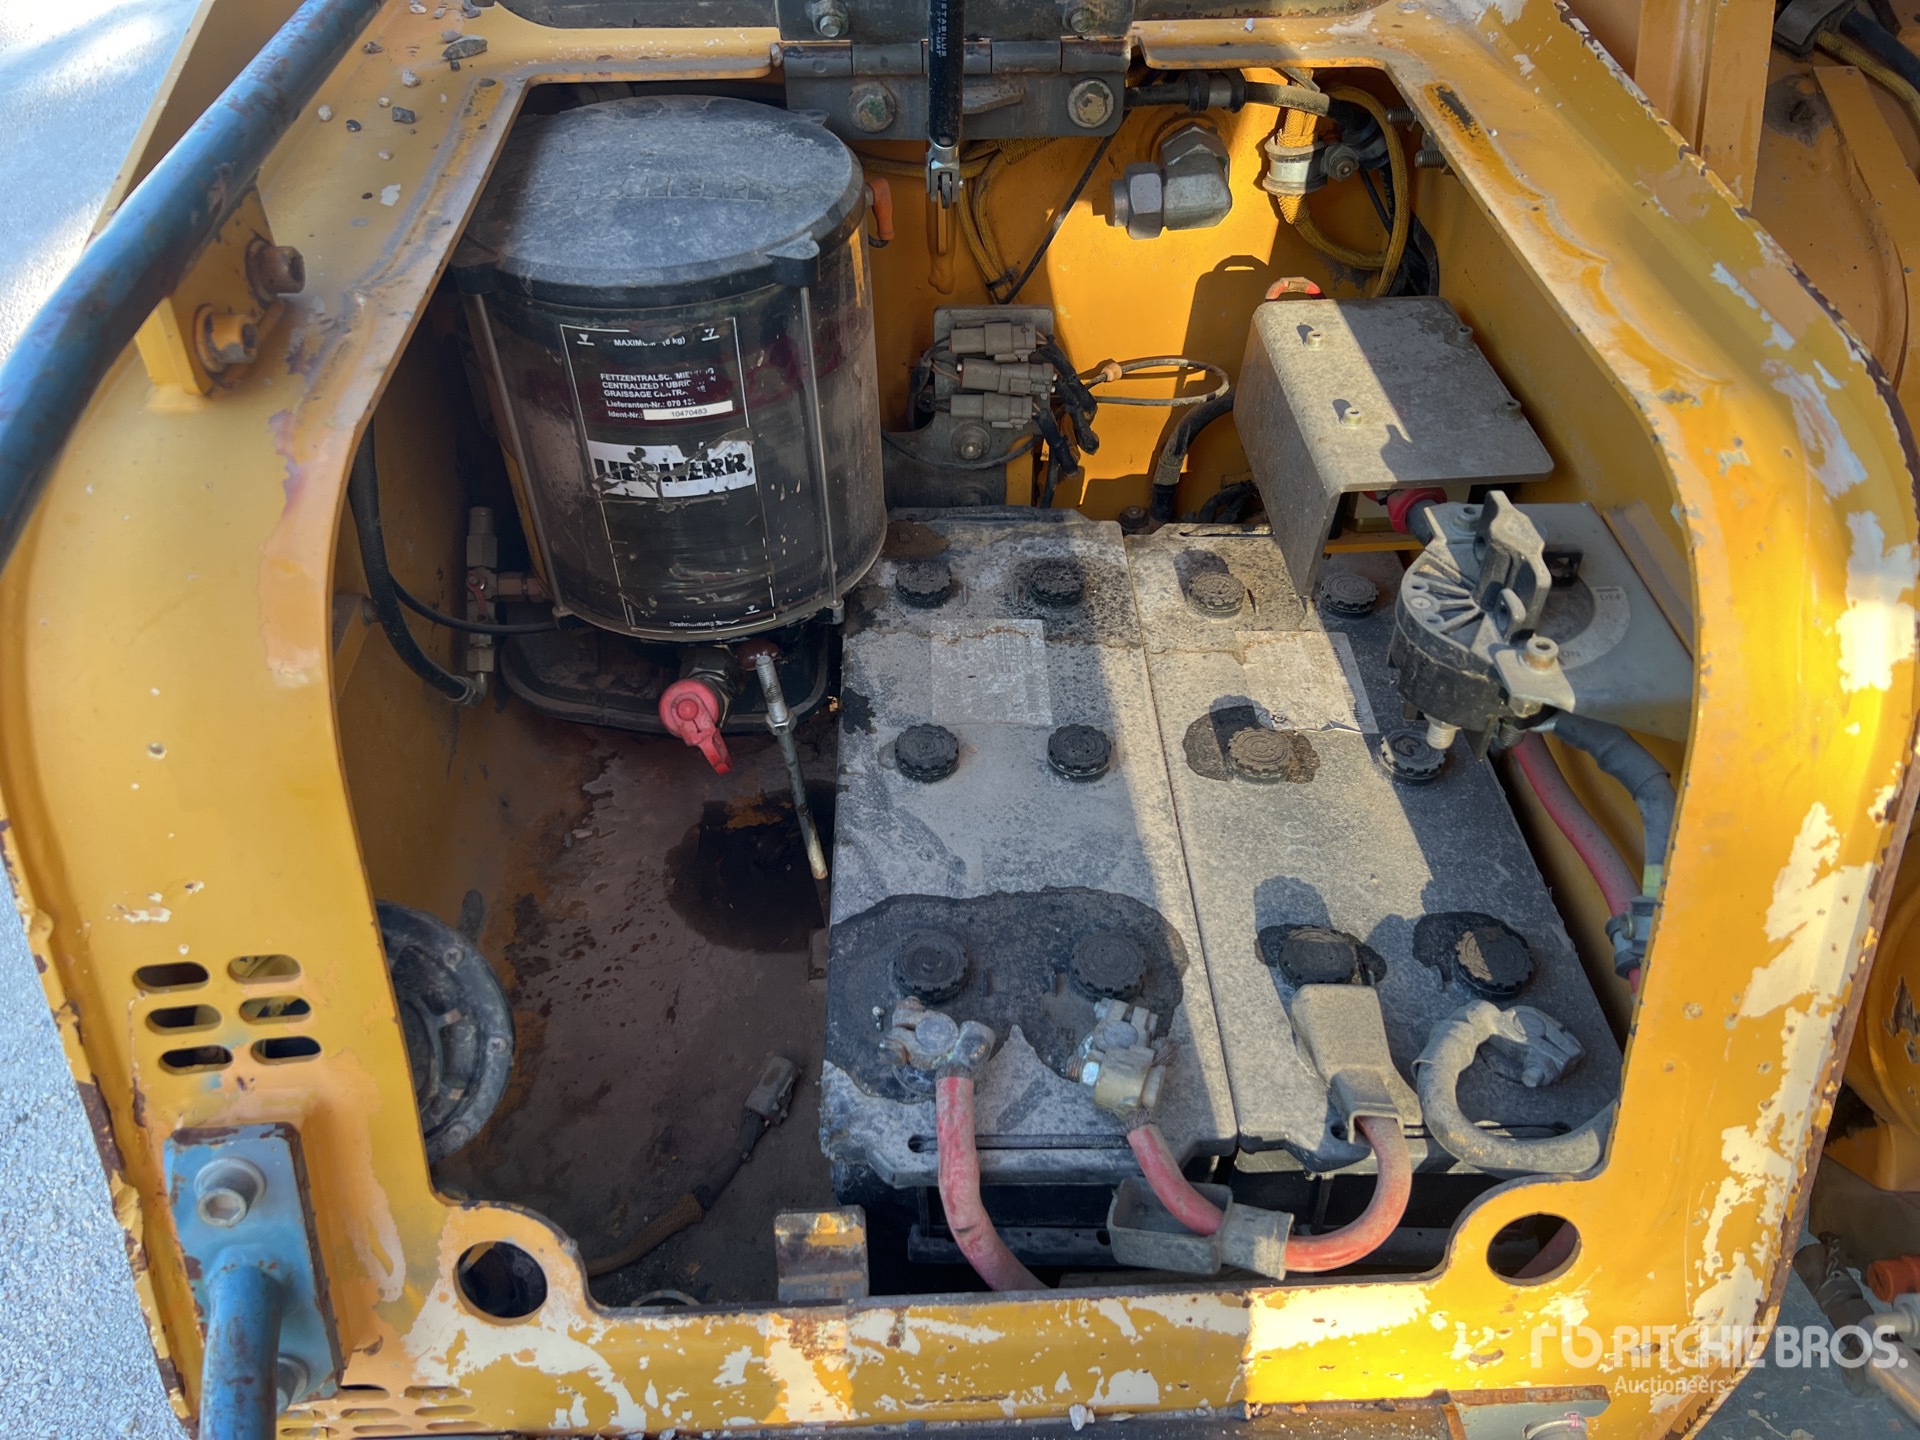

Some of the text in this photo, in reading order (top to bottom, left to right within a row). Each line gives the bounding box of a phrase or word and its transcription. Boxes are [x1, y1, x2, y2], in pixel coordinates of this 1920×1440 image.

[604, 389, 653, 398] GRAISSAGE
[608, 408, 708, 419] Ident-Nr.: 10470483
